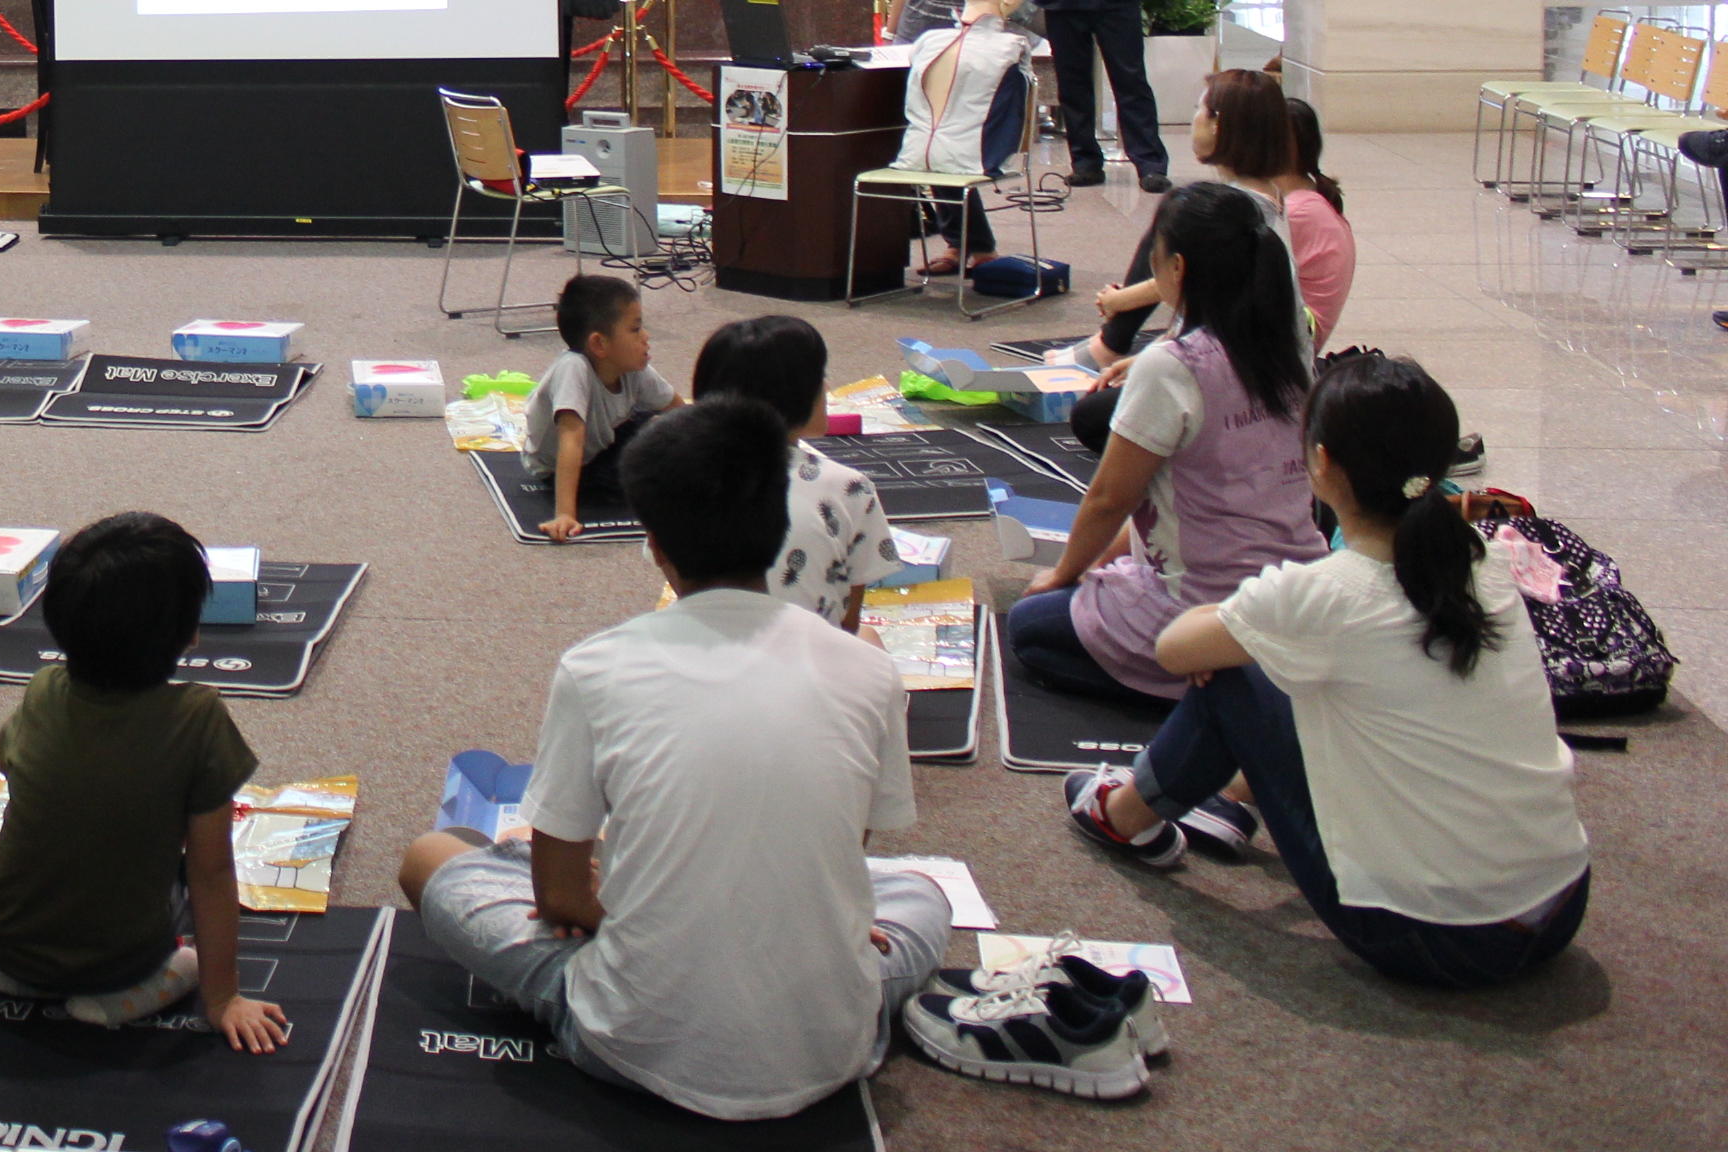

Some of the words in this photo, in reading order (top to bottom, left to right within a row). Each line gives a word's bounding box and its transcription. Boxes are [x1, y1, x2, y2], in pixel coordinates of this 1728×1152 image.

[104, 365, 158, 383] Mat
[161, 368, 277, 387] Exercise
[155, 408, 206, 416] STEP
[418, 1029, 534, 1063] Mat
